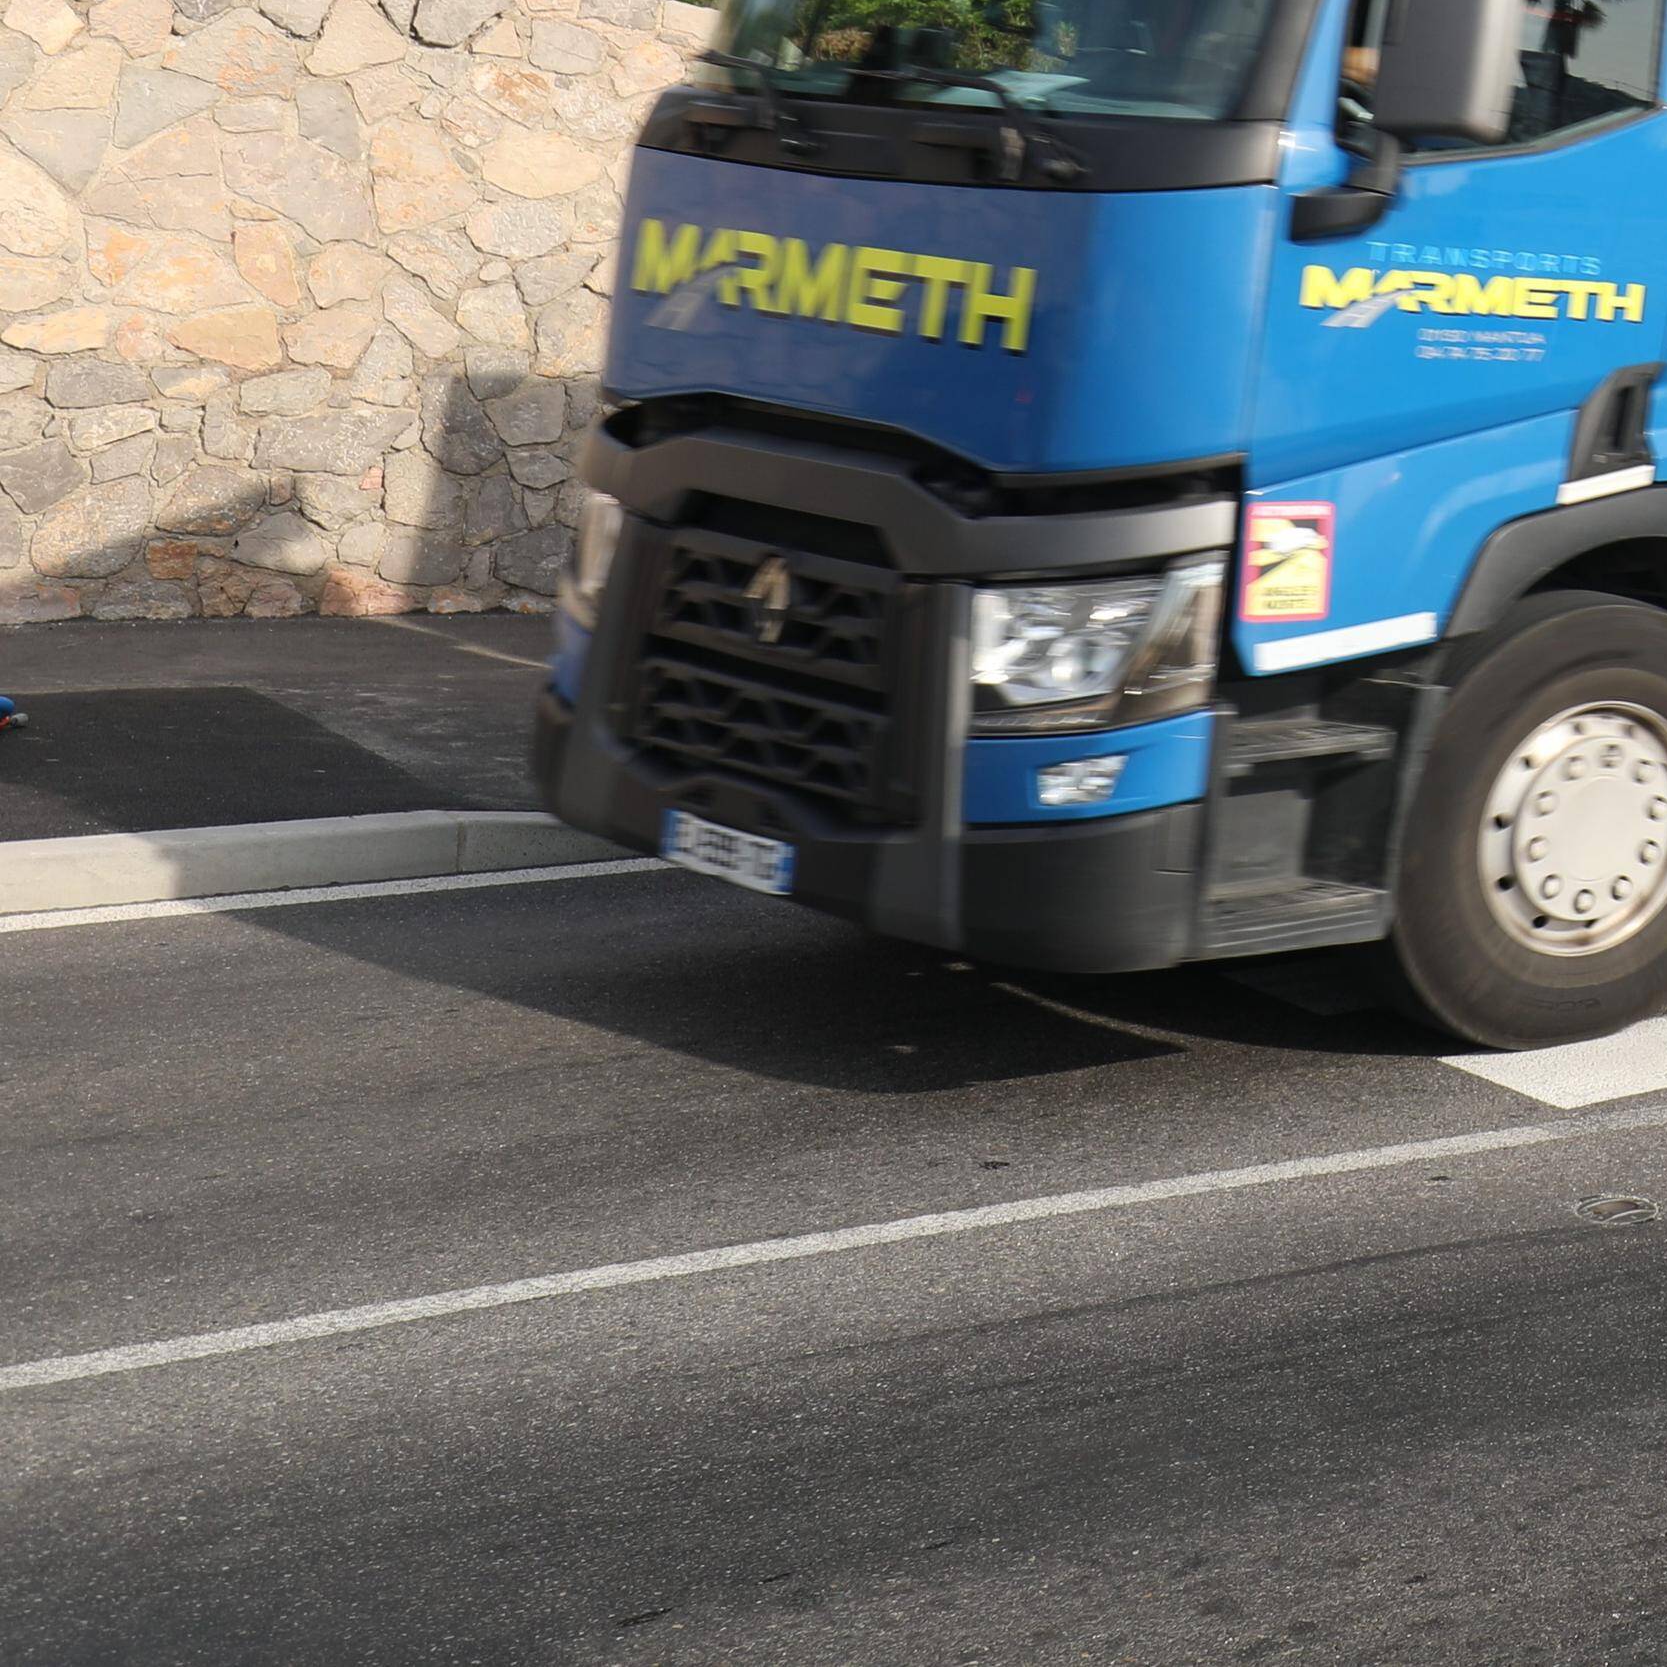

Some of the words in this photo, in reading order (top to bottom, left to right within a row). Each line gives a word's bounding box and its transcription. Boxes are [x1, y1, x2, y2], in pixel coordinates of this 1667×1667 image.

[630, 218, 1037, 351] MARMETH
[1366, 241, 1602, 275] TRANSPORTS
[1299, 264, 1647, 323] MARMETH
